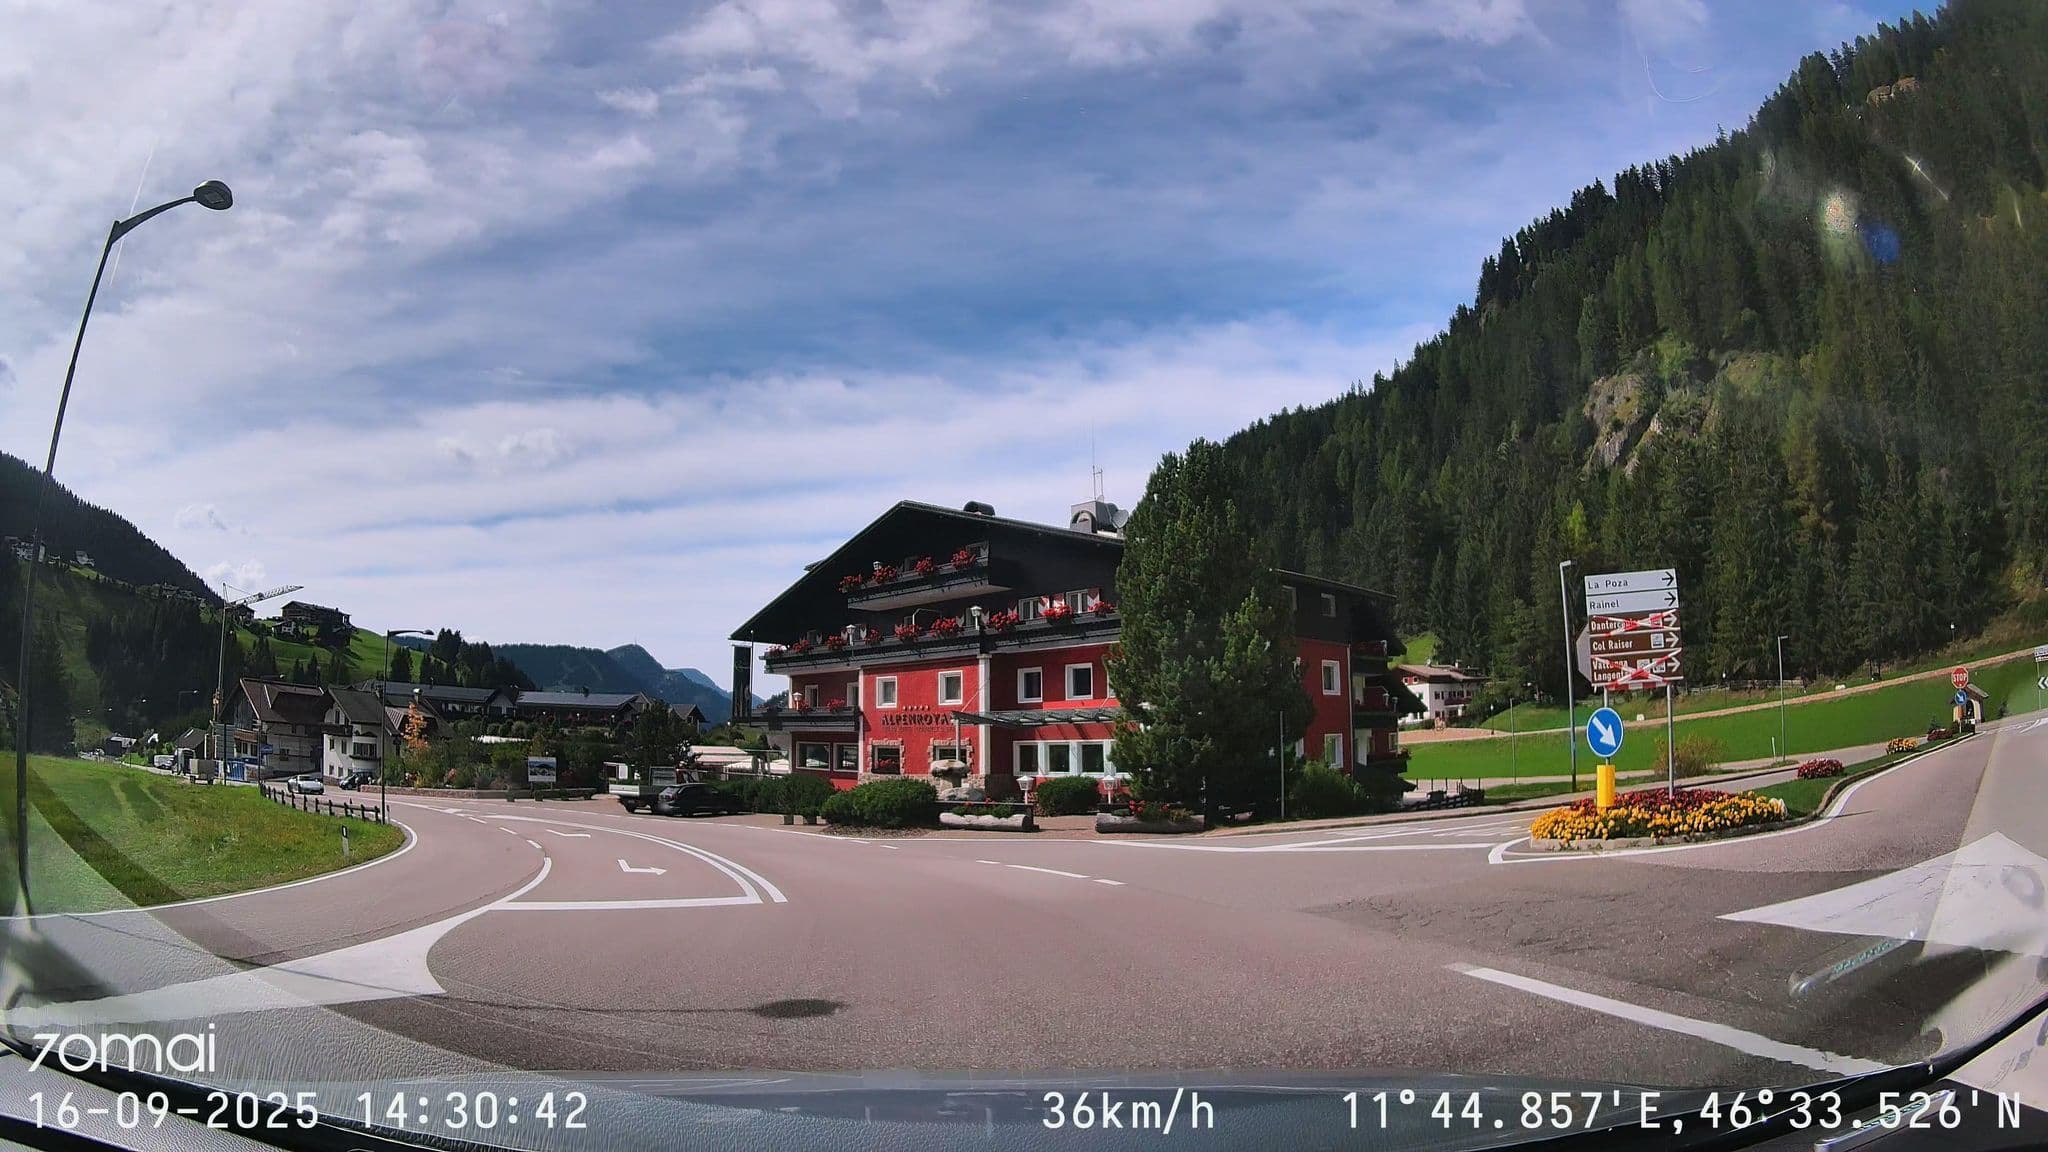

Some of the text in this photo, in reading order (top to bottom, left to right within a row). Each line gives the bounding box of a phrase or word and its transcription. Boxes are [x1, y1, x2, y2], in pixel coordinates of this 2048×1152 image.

[1588, 579, 1628, 589] La Poza
[1589, 599, 1620, 610] Rainel
[1592, 640, 1633, 651] Col Raiser
[1953, 672, 1967, 682] STOP
[882, 713, 954, 726] ALPENROYA
